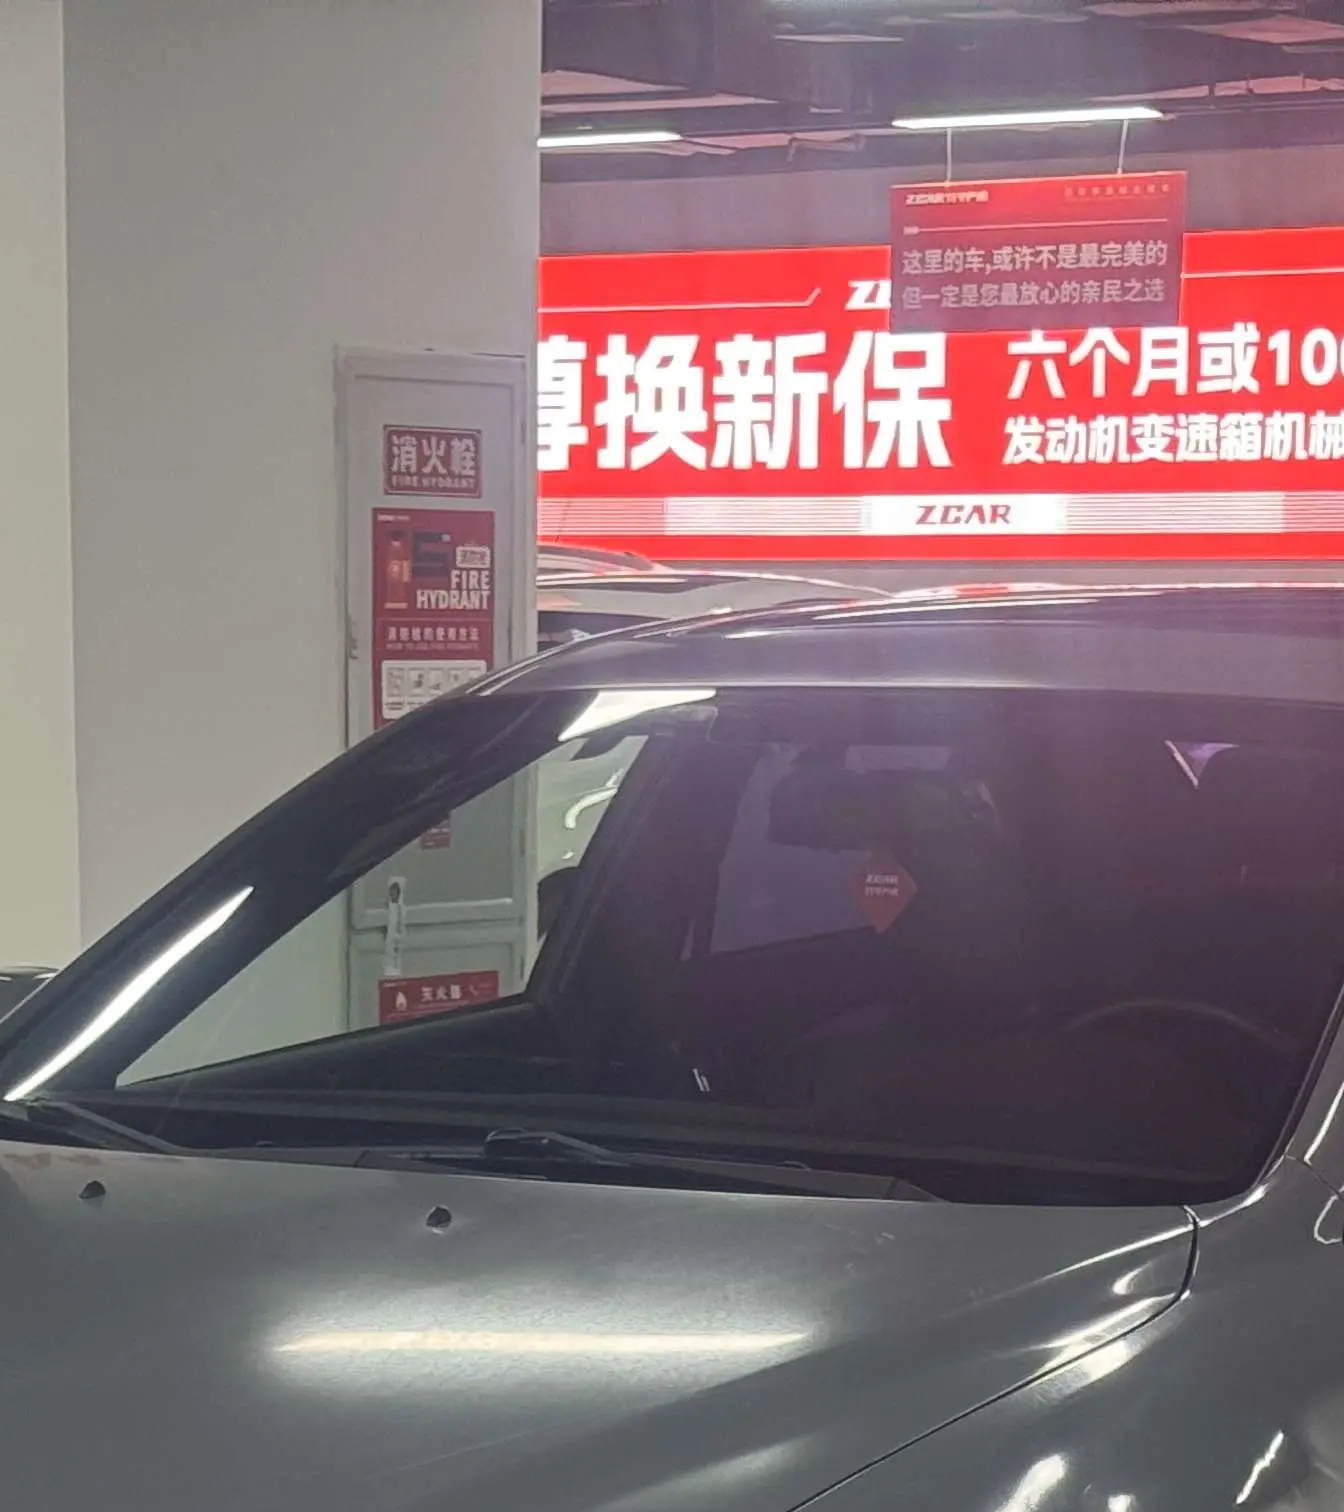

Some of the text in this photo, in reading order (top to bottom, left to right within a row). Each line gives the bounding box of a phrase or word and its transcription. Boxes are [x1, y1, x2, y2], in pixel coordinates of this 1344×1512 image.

[902, 239, 1169, 276] 这里的车,或许不是最完美的
[902, 277, 1165, 311] 但一定是您最放心的亲民之选
[391, 434, 476, 476] 消火栓
[915, 505, 1012, 527] ZCAR
[450, 569, 491, 590] FIRE
[415, 588, 492, 610] HYDRANT
